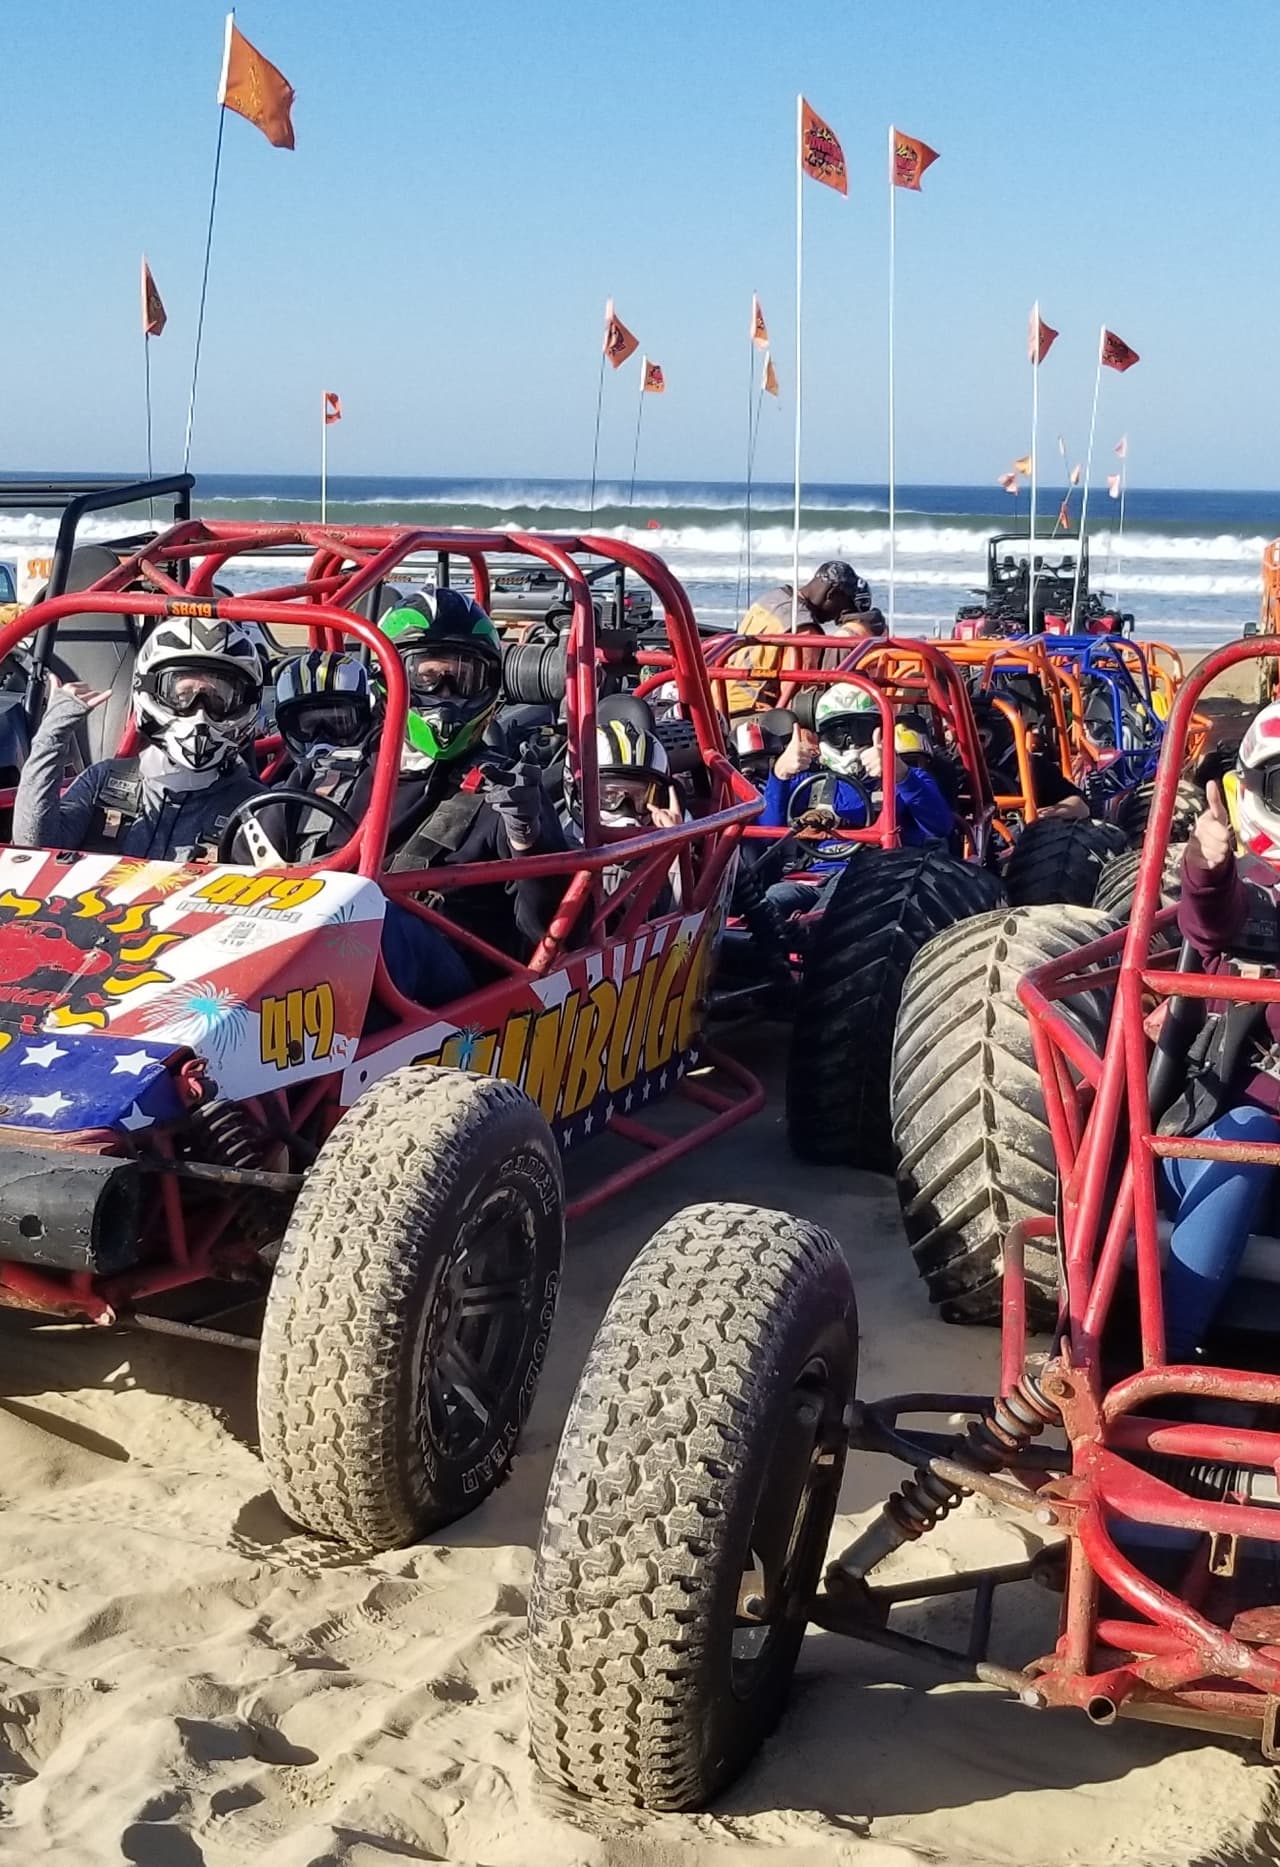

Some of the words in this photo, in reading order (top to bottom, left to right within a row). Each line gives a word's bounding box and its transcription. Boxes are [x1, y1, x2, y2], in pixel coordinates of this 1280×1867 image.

[171, 601, 212, 616] SB419
[189, 873, 326, 910] 419
[260, 981, 335, 1070] 419
